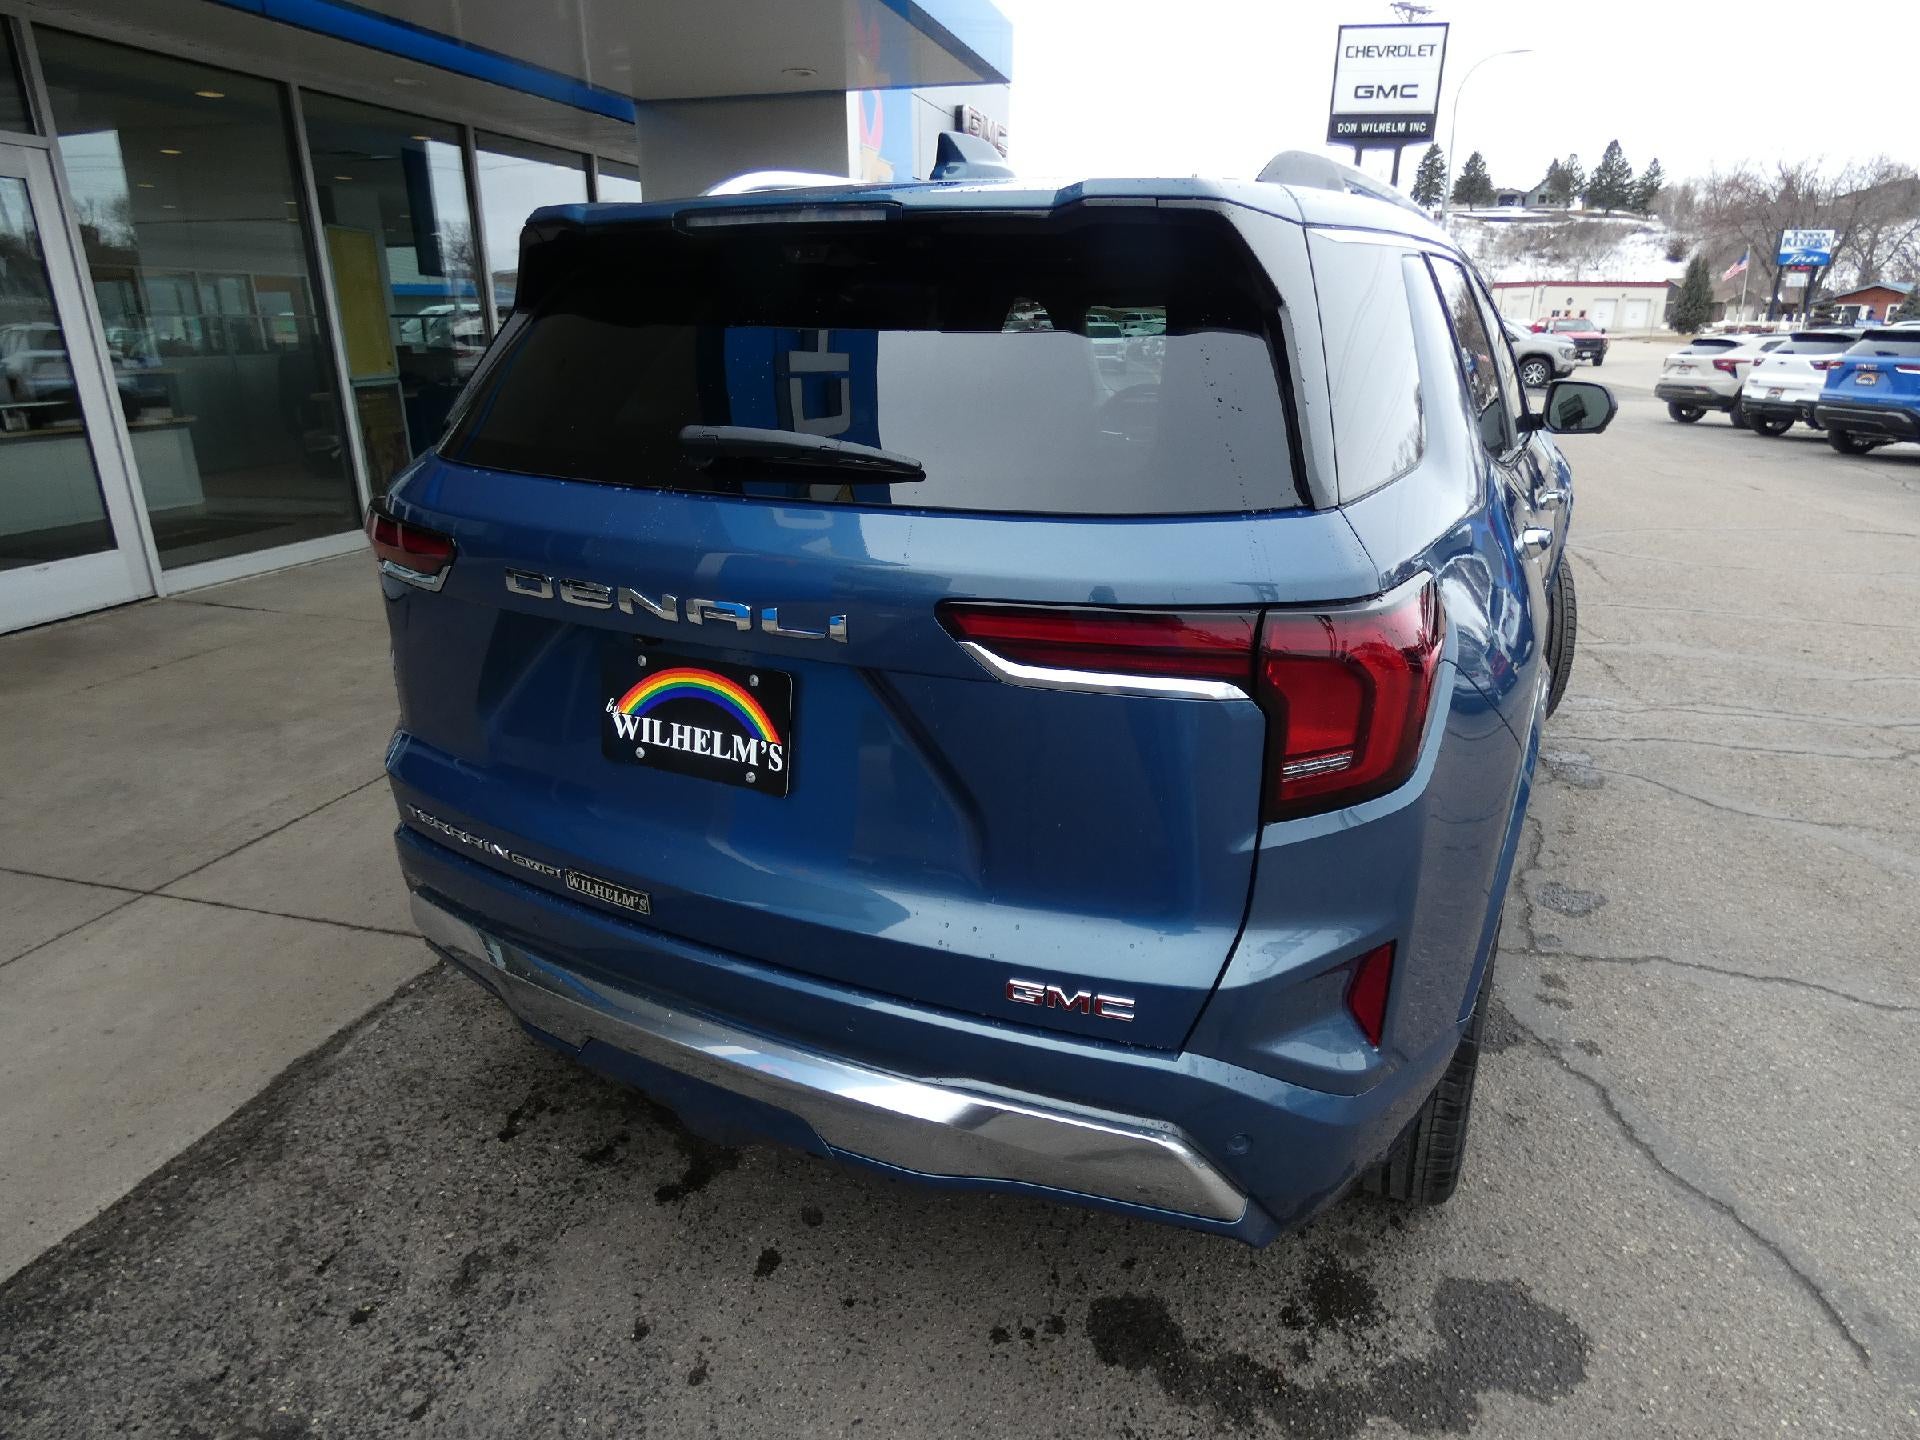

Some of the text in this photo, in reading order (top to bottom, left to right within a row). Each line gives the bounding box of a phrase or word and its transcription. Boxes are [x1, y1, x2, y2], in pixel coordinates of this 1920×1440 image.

[1345, 44, 1437, 58] CHEVROLET
[1354, 84, 1418, 99] GMC
[1337, 121, 1427, 133] DON WILHELM INC
[505, 566, 848, 644] DENALI
[605, 698, 622, 718] by
[614, 712, 783, 772] WILHELM'S
[406, 803, 512, 861] TERRAIN
[567, 872, 648, 911] WILHELM'S
[1006, 978, 1136, 1023] GMC
